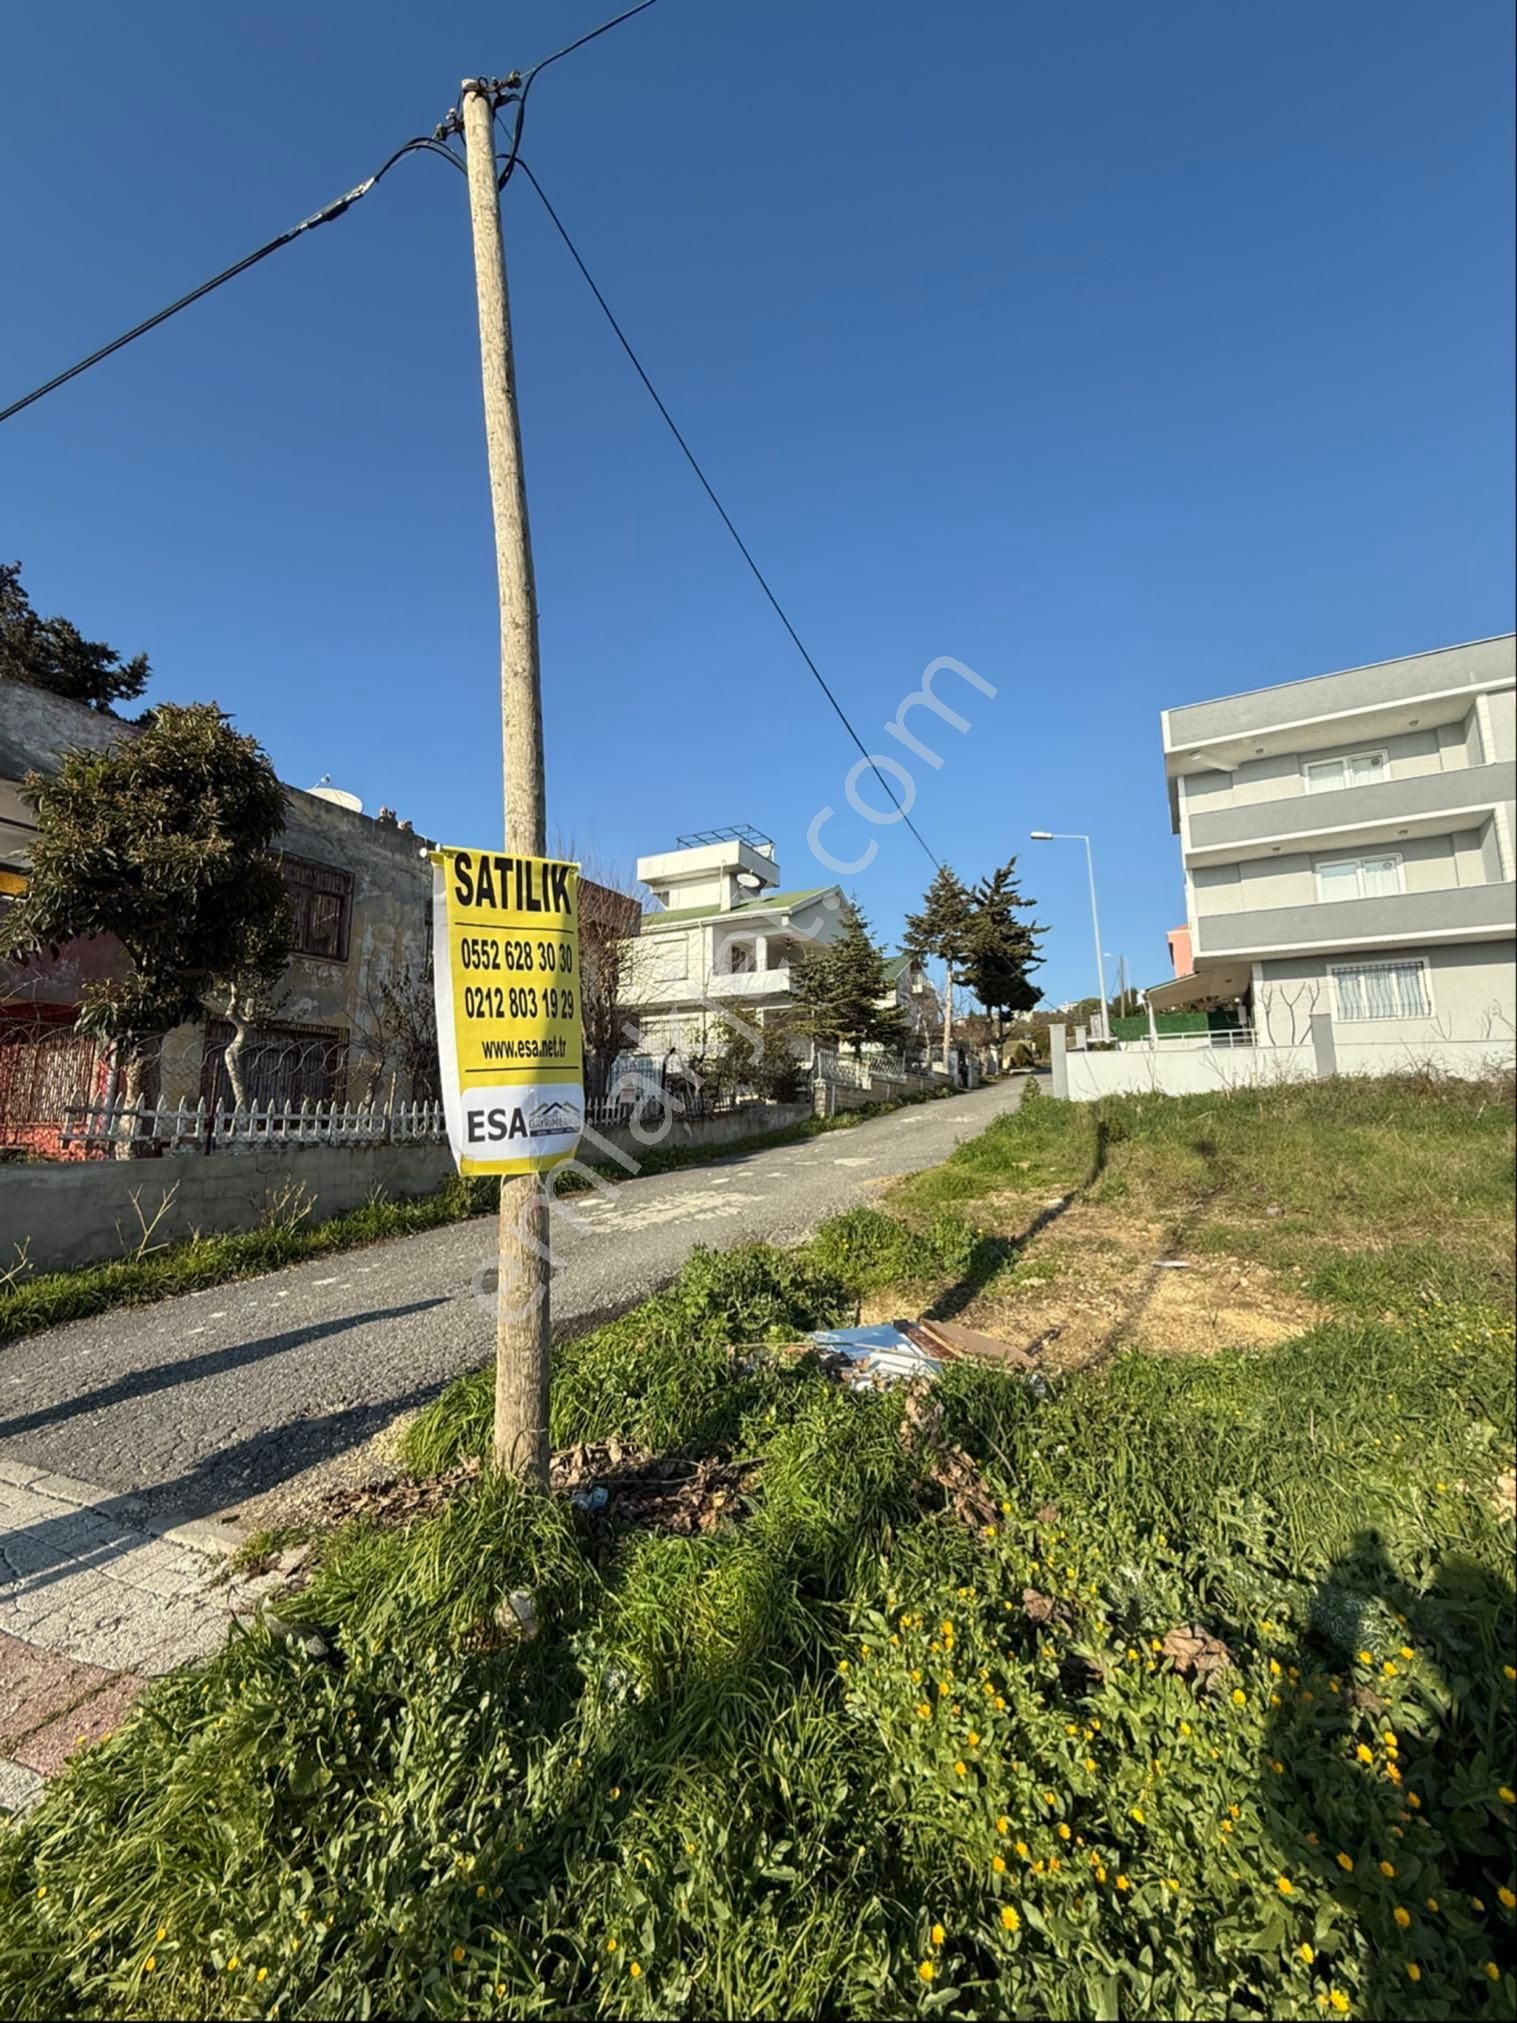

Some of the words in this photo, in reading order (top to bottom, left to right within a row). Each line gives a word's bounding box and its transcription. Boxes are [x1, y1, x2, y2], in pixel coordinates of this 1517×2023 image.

[454, 852, 572, 915] SATILIK
[461, 937, 501, 970] 0552
[505, 940, 534, 971] 628
[537, 941, 556, 972] 30
[559, 943, 573, 974] 30
[465, 986, 505, 1018] 0212
[509, 987, 538, 1018] 803
[542, 987, 558, 1018] 19
[561, 989, 575, 1019] 29
[481, 1035, 567, 1060] www.esa.net.tr
[467, 1107, 528, 1143] ESA
